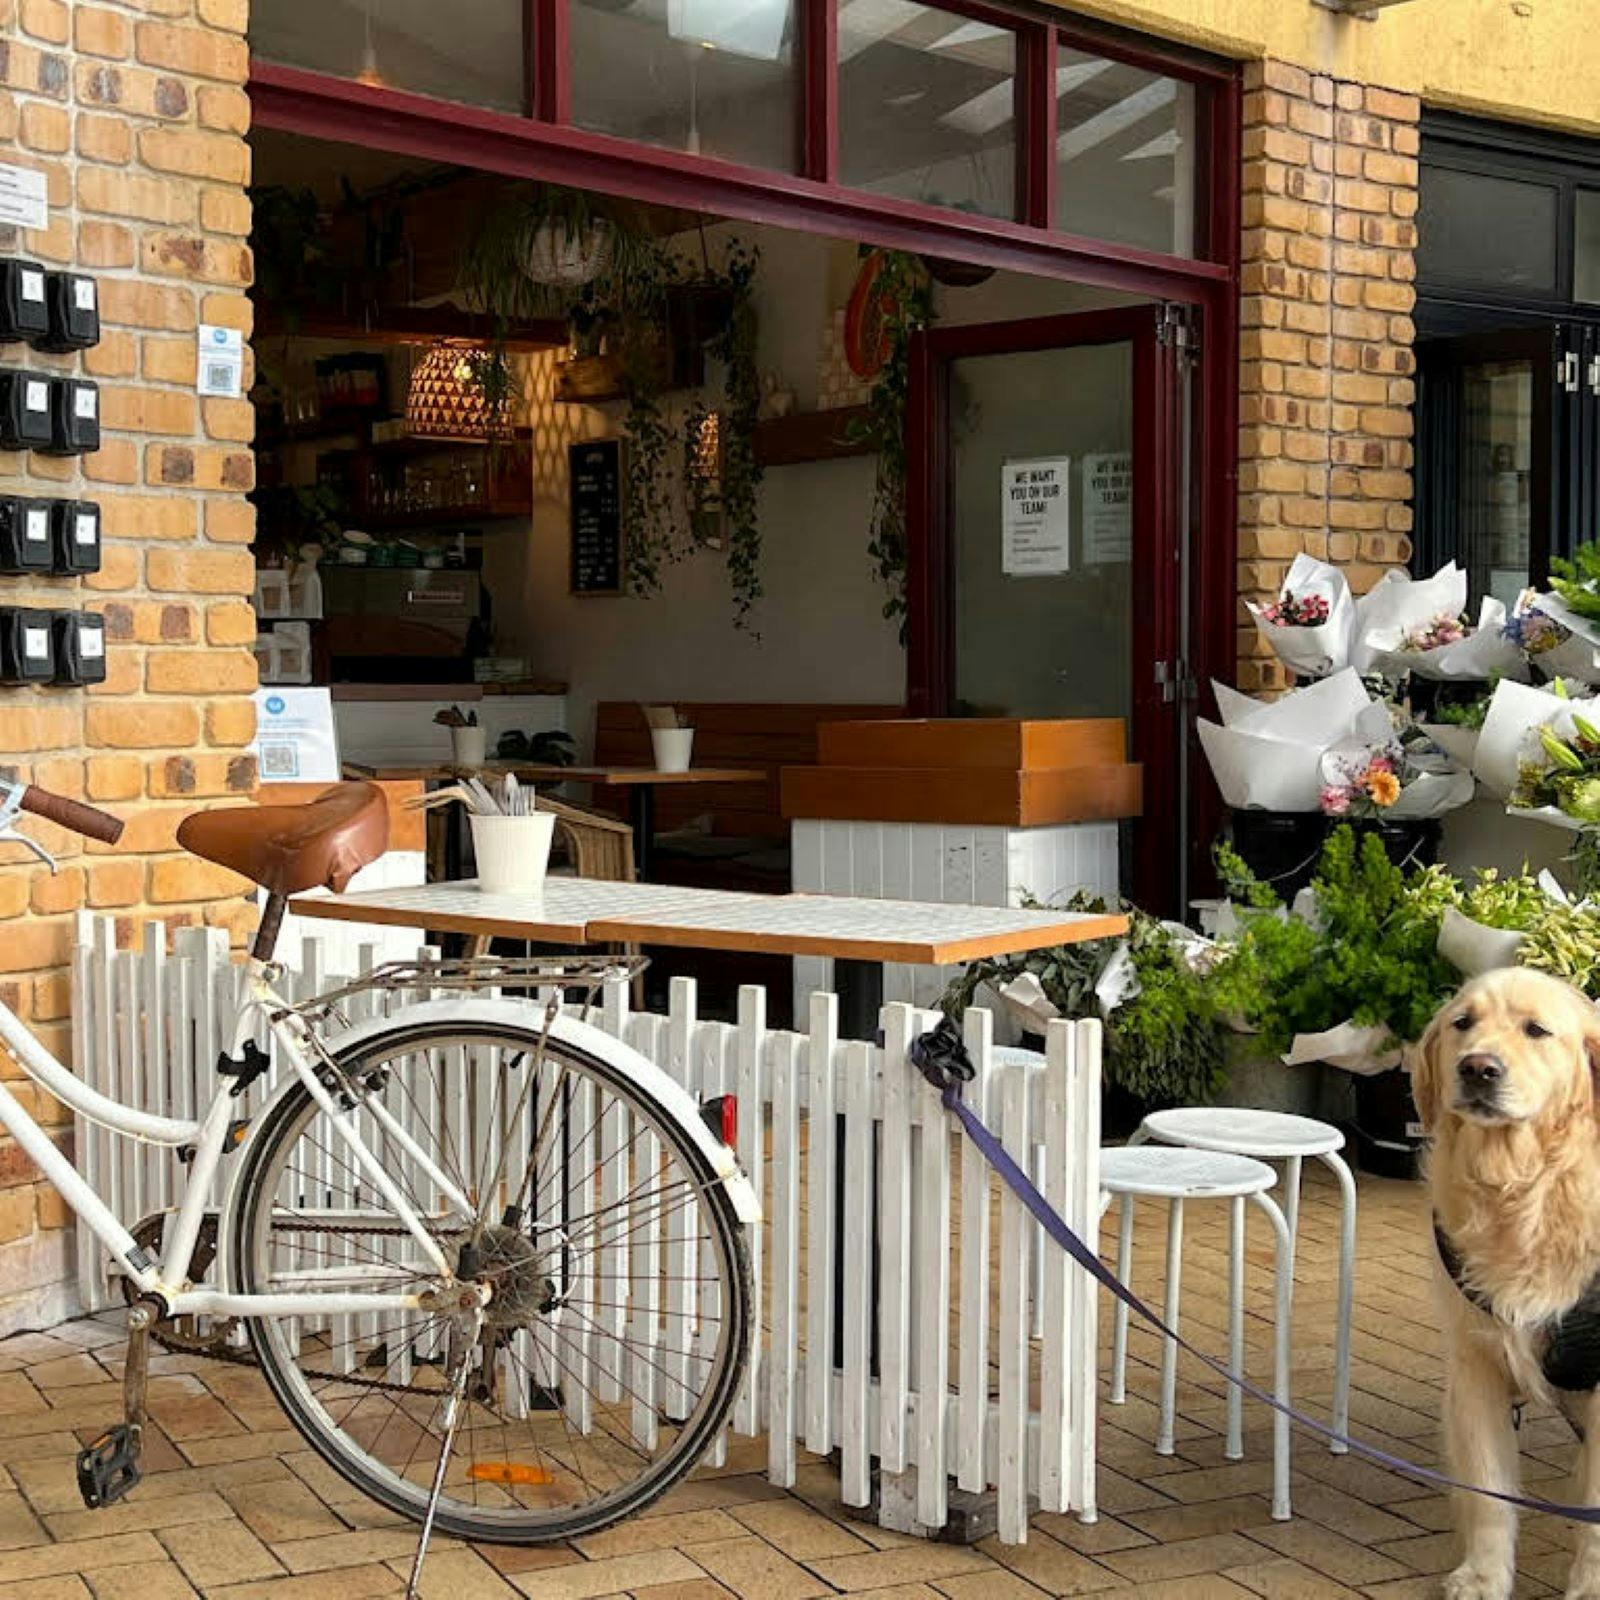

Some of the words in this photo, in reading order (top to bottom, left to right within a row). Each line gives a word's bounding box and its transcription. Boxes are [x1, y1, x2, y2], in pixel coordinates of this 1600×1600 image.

[1015, 471, 1029, 484] WE
[1031, 470, 1055, 482] WANT
[1010, 486, 1027, 500] YOU
[1029, 485, 1040, 499] ON
[1043, 485, 1060, 498] OUR
